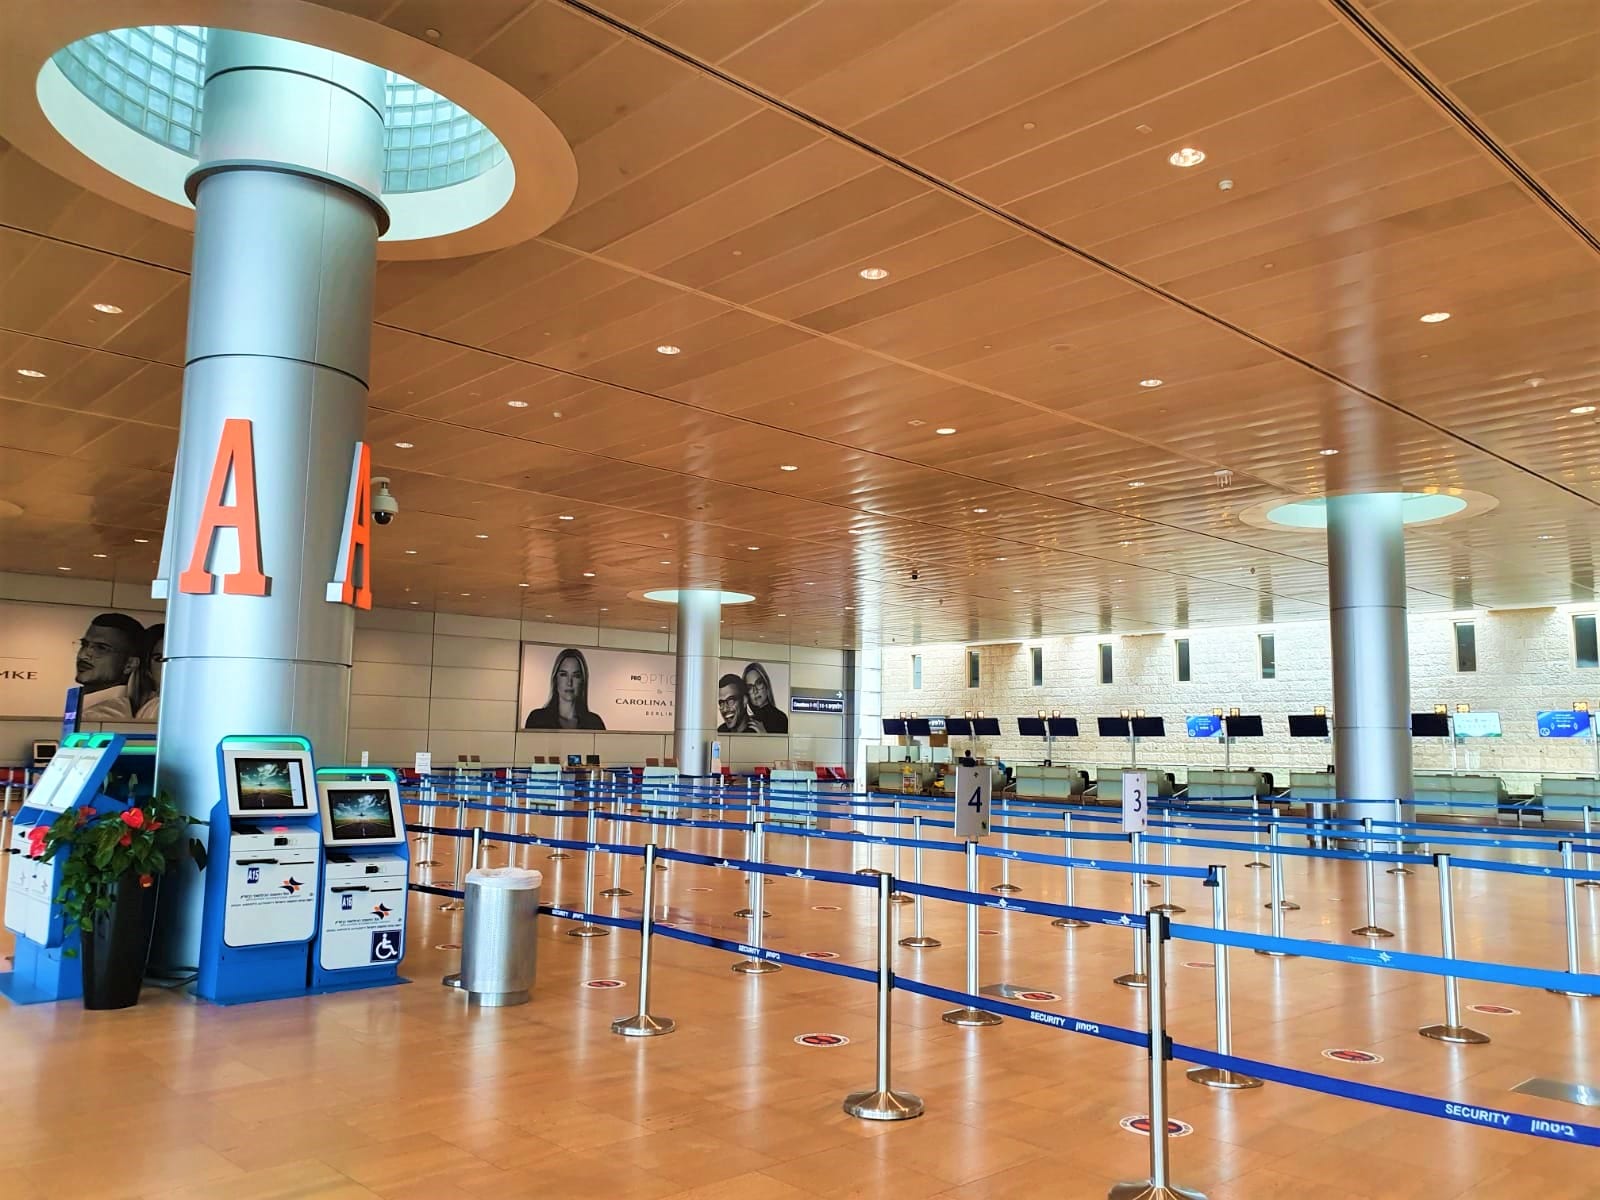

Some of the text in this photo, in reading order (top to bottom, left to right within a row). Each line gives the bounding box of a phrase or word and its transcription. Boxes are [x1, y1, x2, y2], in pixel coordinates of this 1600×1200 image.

[178, 418, 271, 596] A
[328, 441, 373, 610] A
[615, 698, 667, 706] CAROLINA
[967, 786, 983, 813] 4
[1133, 789, 1142, 812] 3
[248, 869, 259, 881] A15
[738, 944, 760, 956] SECURITY
[1030, 1011, 1099, 1033] SECURITY ביטחון
[1445, 1103, 1576, 1136] SECURITY ביטחון
